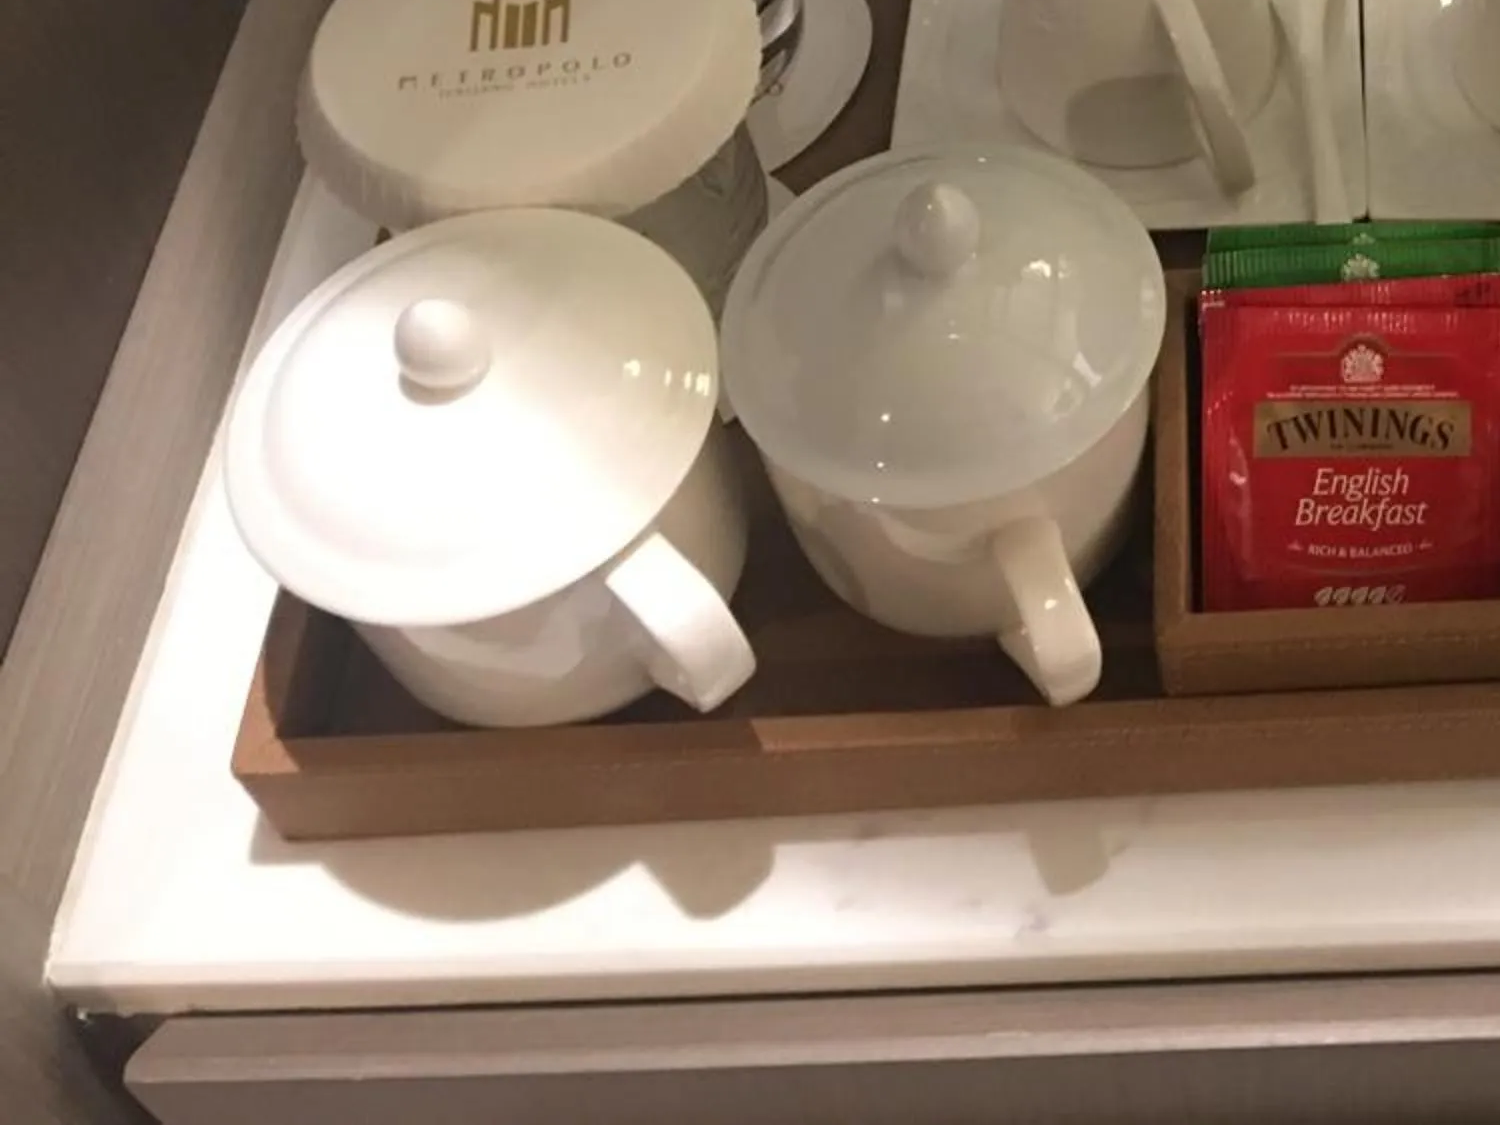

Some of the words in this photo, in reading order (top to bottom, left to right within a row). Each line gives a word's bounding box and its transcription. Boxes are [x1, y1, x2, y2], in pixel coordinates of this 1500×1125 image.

[1266, 406, 1456, 452] TWININGS
[1312, 467, 1410, 503] English
[1295, 498, 1428, 532] Breakfast
